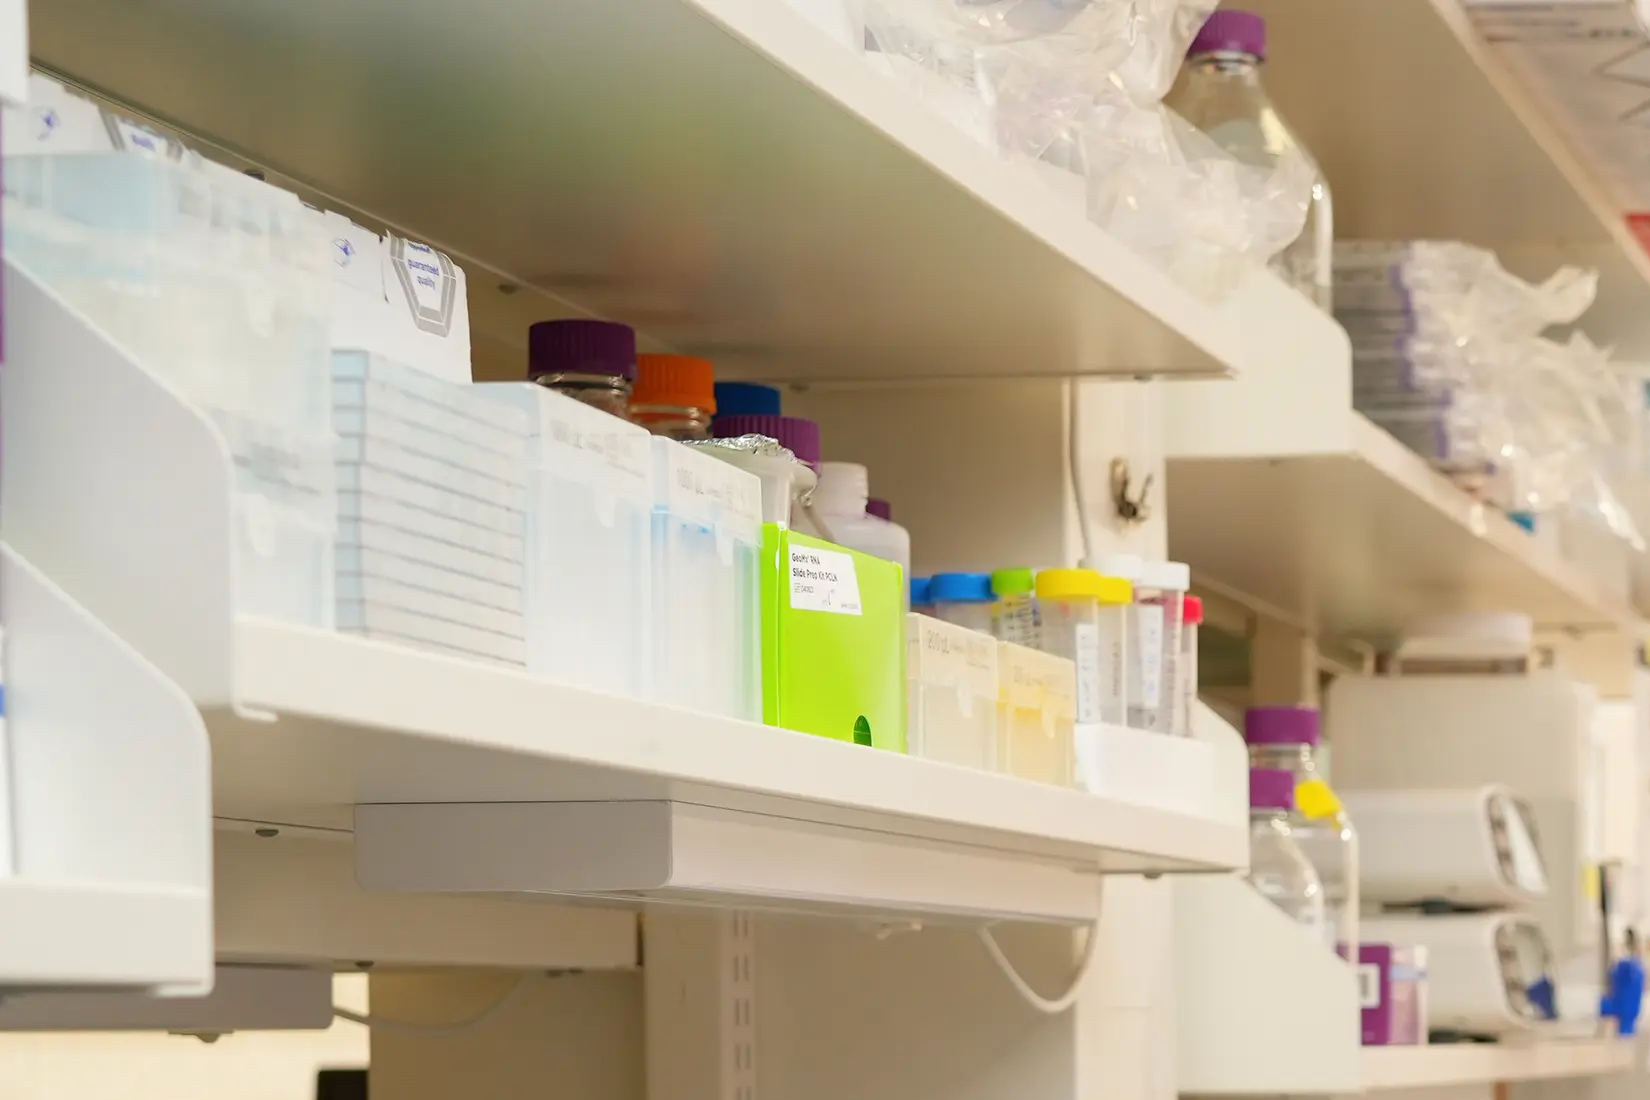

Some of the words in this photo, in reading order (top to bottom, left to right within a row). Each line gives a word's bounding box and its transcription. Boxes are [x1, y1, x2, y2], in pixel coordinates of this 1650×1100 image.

[407, 259, 439, 276] guaranteed
[417, 275, 435, 290] quality
[810, 555, 820, 565] RNA
[792, 567, 806, 578] Slide
[806, 568, 818, 580] Prep
